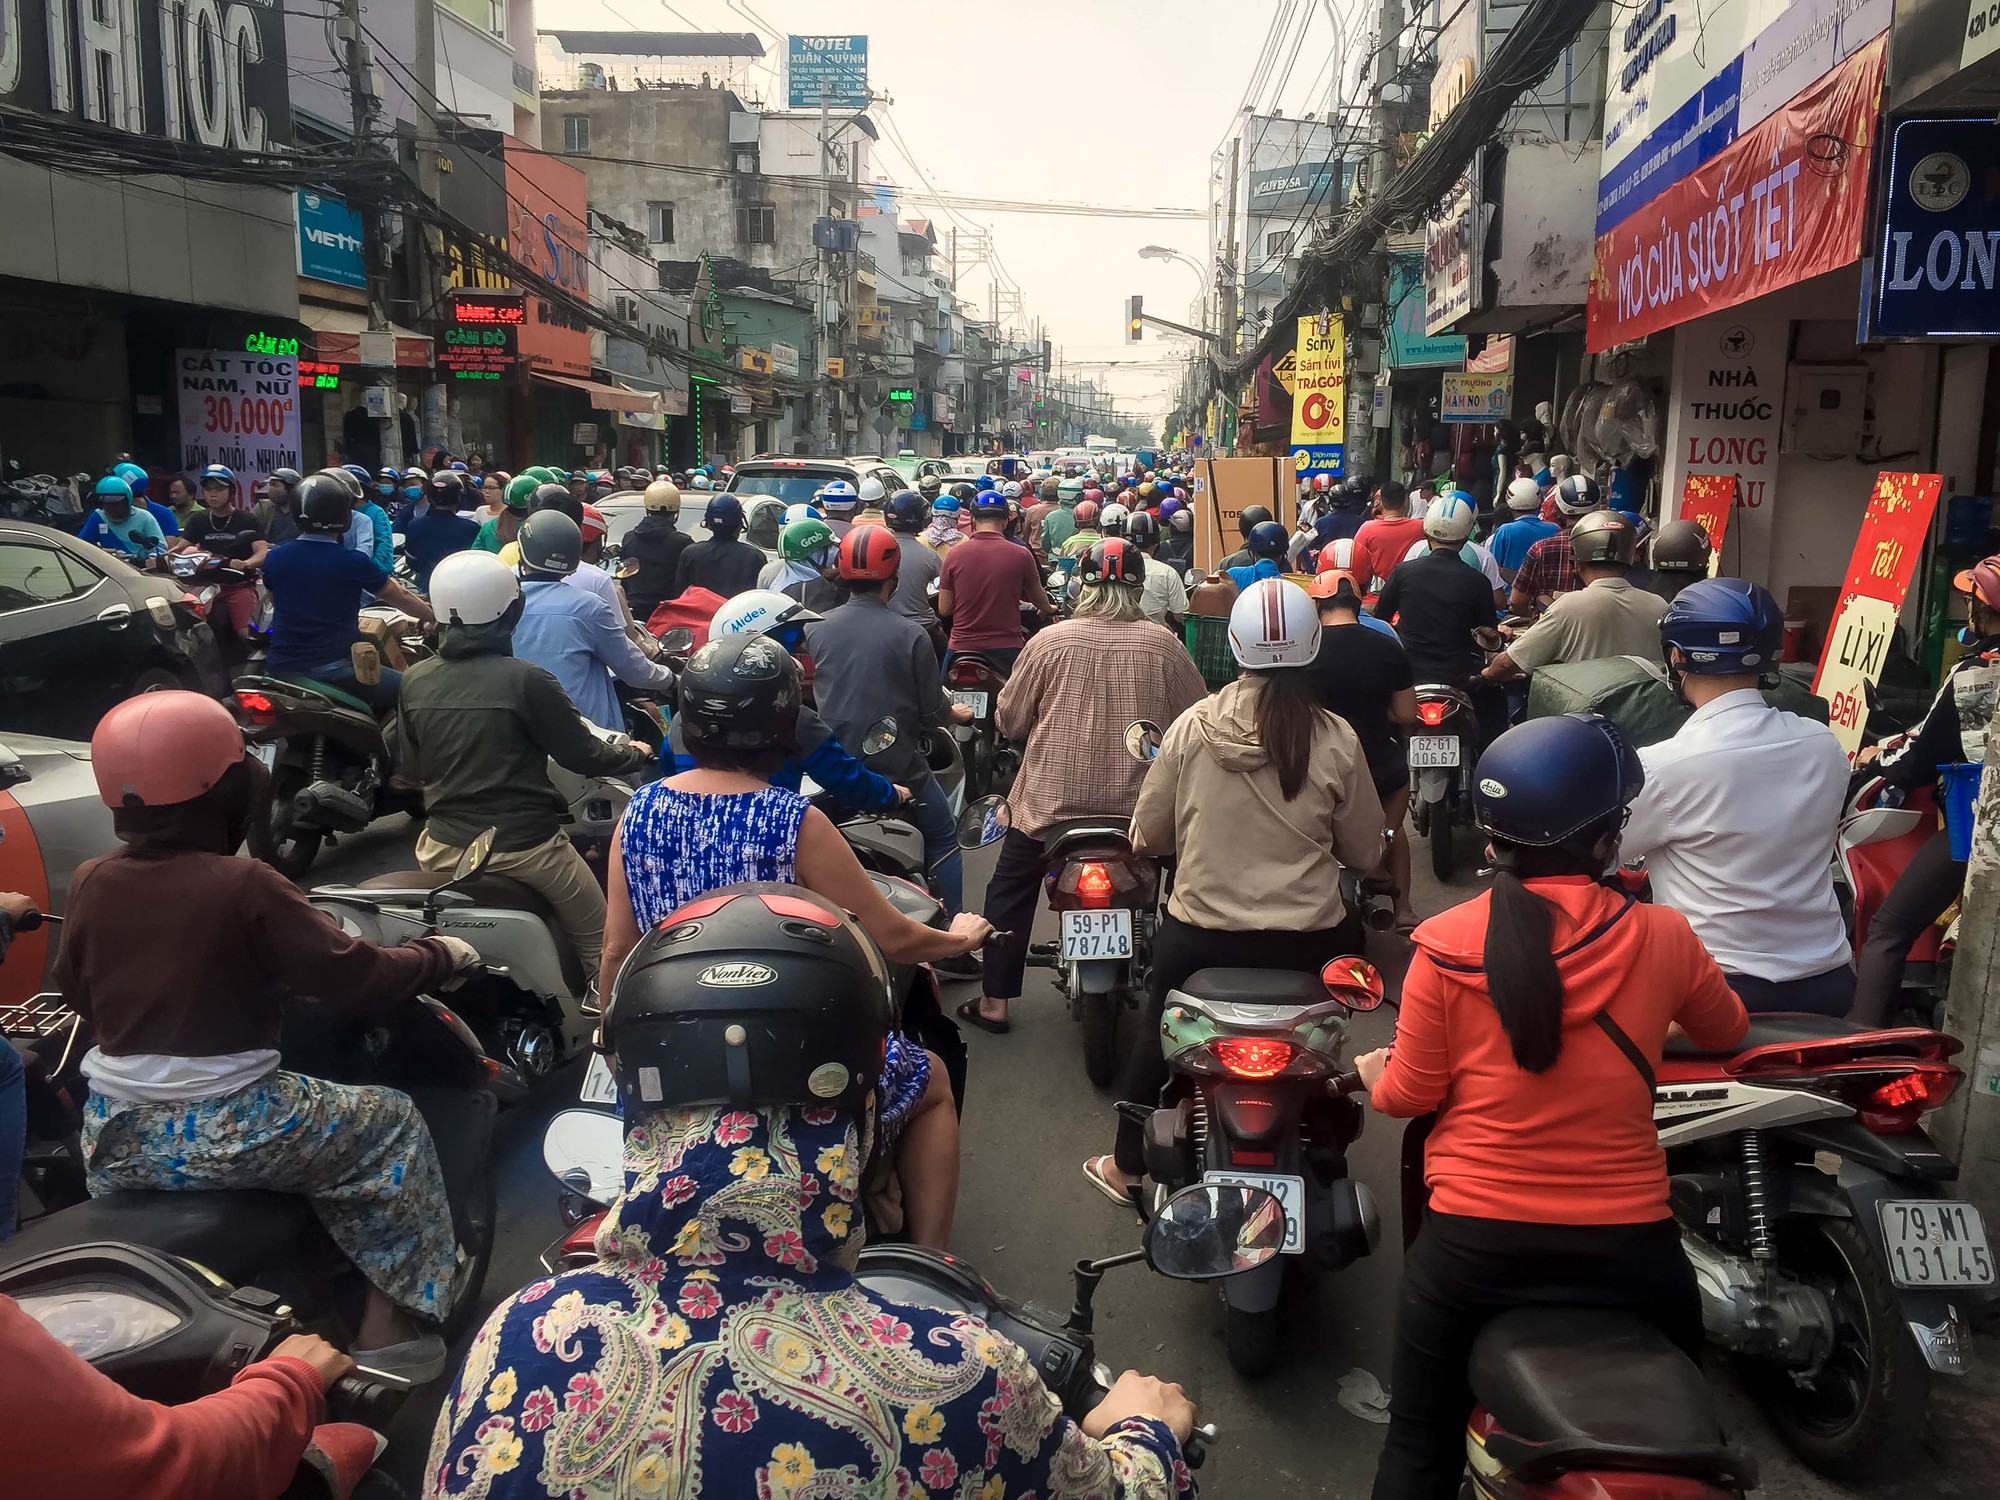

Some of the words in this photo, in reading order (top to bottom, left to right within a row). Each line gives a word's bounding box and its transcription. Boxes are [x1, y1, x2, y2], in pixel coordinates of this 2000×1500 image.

[1967, 11, 1986, 39] 420
[802, 37, 852, 51] HOTEL
[1618, 235, 1644, 323] MỞ
[1647, 216, 1684, 309] CỬA
[1687, 164, 1745, 292] SUỐT
[1751, 126, 1800, 266] TẾT
[543, 212, 588, 292] SUN
[1888, 230, 2000, 291] LON
[1306, 338, 1335, 353] Sony
[182, 353, 230, 373] CẮT
[240, 357, 292, 376] TÓC
[1299, 358, 1321, 371] Sắm
[182, 376, 247, 395] NAM,
[256, 378, 292, 396] NỮ
[1297, 373, 1317, 389] TRẢ
[1317, 373, 1343, 388] GÓP
[1708, 366, 1758, 387] NHÀ
[1302, 392, 1340, 430] 0%
[1691, 396, 1773, 420] THUỐC
[1688, 437, 1767, 465] LONG
[1310, 459, 1340, 469] XANH
[801, 532, 823, 547] Grab
[1870, 538, 1902, 580] Tết!
[730, 606, 766, 633] Midea
[1692, 652, 1717, 661] GRS
[1830, 684, 1861, 731] ĐẾN
[1419, 738, 1450, 751] 62-G1
[1413, 752, 1456, 765] 106.67
[1482, 781, 1501, 795] Asia
[1073, 914, 1118, 934] 59-P1
[1068, 935, 1127, 957] 787.48
[703, 965, 769, 981] NonViet
[1895, 1207, 1969, 1242] 79-N1
[1896, 1246, 1990, 1281] 131.45
